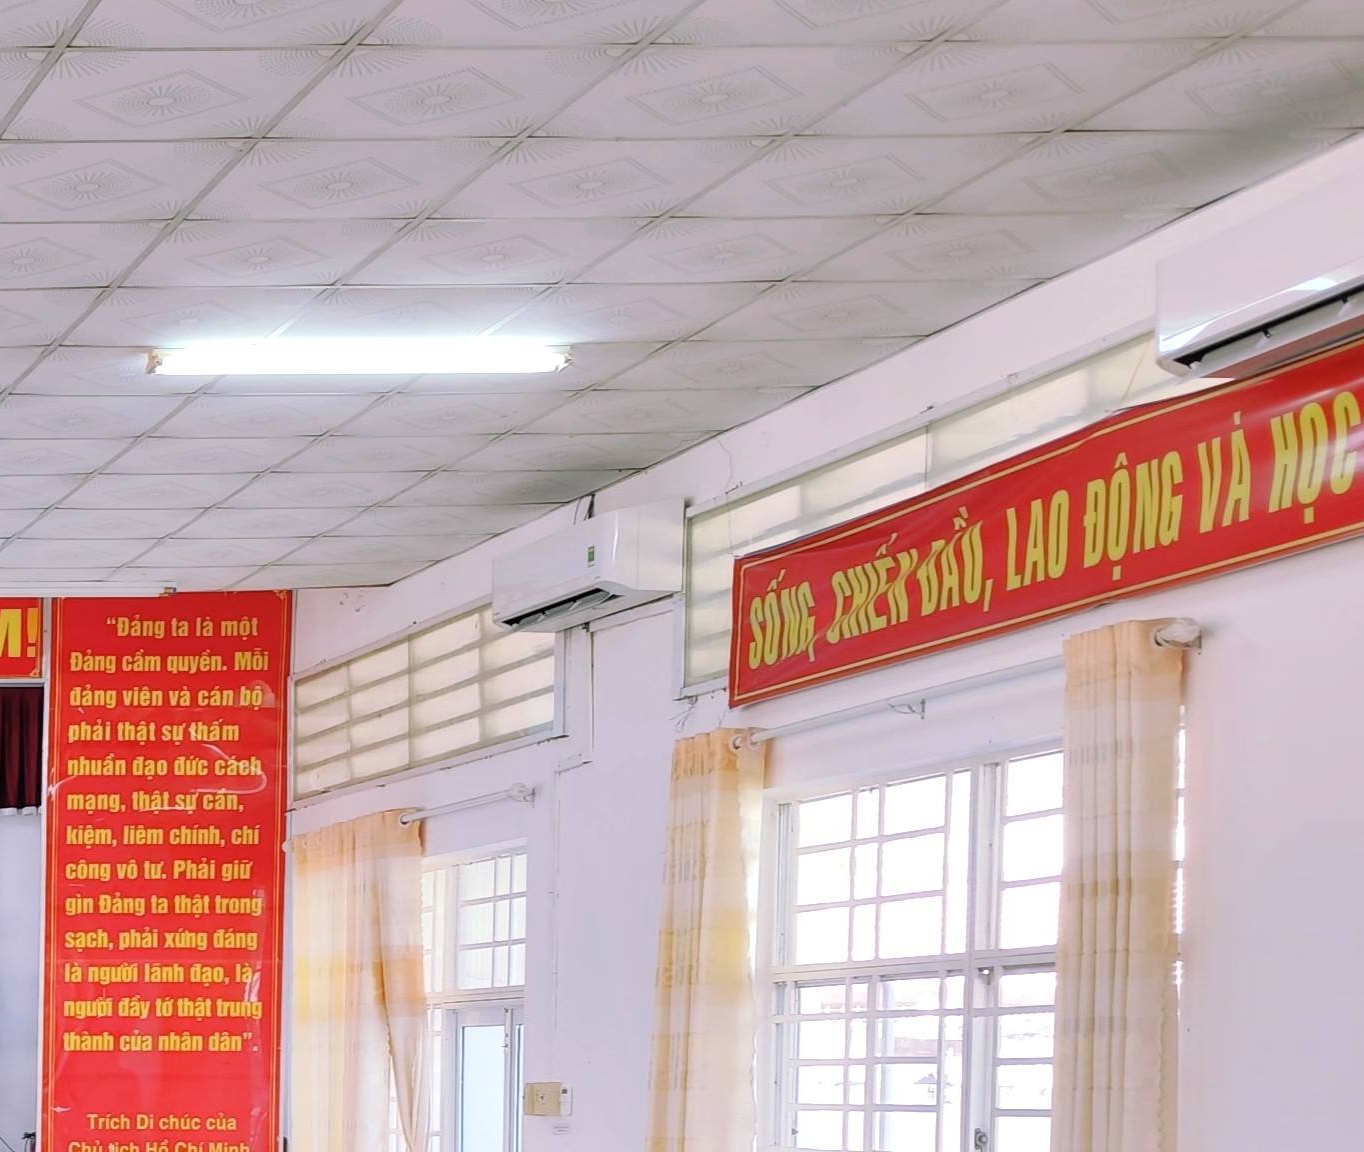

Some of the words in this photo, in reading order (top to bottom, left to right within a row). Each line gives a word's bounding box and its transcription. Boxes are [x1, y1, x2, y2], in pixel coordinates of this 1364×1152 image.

[826, 533, 919, 644] CHIẾN
[1005, 490, 1068, 590] LAO
[1082, 451, 1185, 581] ĐỘNG
[1269, 391, 1362, 524] HỌC
[171, 617, 188, 636] ta
[196, 616, 213, 636] là
[221, 617, 258, 640] một
[70, 649, 116, 673] Đảng
[122, 649, 160, 671] cầm
[167, 650, 227, 674] quyền.
[234, 648, 268, 671] Mỗi
[70, 684, 116, 708] đảng
[123, 687, 162, 706] viên
[169, 685, 190, 706] và
[198, 686, 233, 706] cán
[68, 718, 110, 743] phải
[118, 722, 156, 745] thật
[68, 753, 125, 775] nhuần
[133, 757, 167, 780] đạo
[174, 756, 208, 775] đức
[67, 793, 125, 814] mạng,
[66, 825, 117, 848] kiệm,
[123, 826, 163, 844] liêm
[169, 824, 225, 847] chính,
[231, 824, 259, 844] chí
[65, 859, 110, 881] công
[117, 859, 137, 879] vô
[144, 861, 166, 879] tư.
[173, 858, 215, 879] Phải
[222, 859, 252, 881] giữ
[65, 894, 93, 916] gìn
[99, 892, 145, 916] Đảng
[151, 895, 168, 913] ta
[174, 894, 210, 918] thật
[215, 895, 262, 916] trong
[65, 929, 113, 952] sạch,
[119, 927, 158, 950] phải
[164, 929, 207, 950] xứng
[213, 928, 257, 950] đáng
[65, 963, 82, 983] là
[88, 963, 137, 984] người
[145, 963, 184, 983] lãnh
[190, 963, 229, 987] đạo,
[64, 998, 112, 1018] người
[118, 995, 150, 1019] đầy
[156, 998, 173, 1017] tớ
[178, 998, 212, 1021] thật
[63, 1032, 113, 1051] thành
[120, 1030, 152, 1051] của
[159, 1032, 202, 1051] nhân
[87, 1114, 130, 1130] Trích
[136, 1114, 153, 1130] Di
[159, 1114, 200, 1130] chúc
[206, 1113, 236, 1131] của
